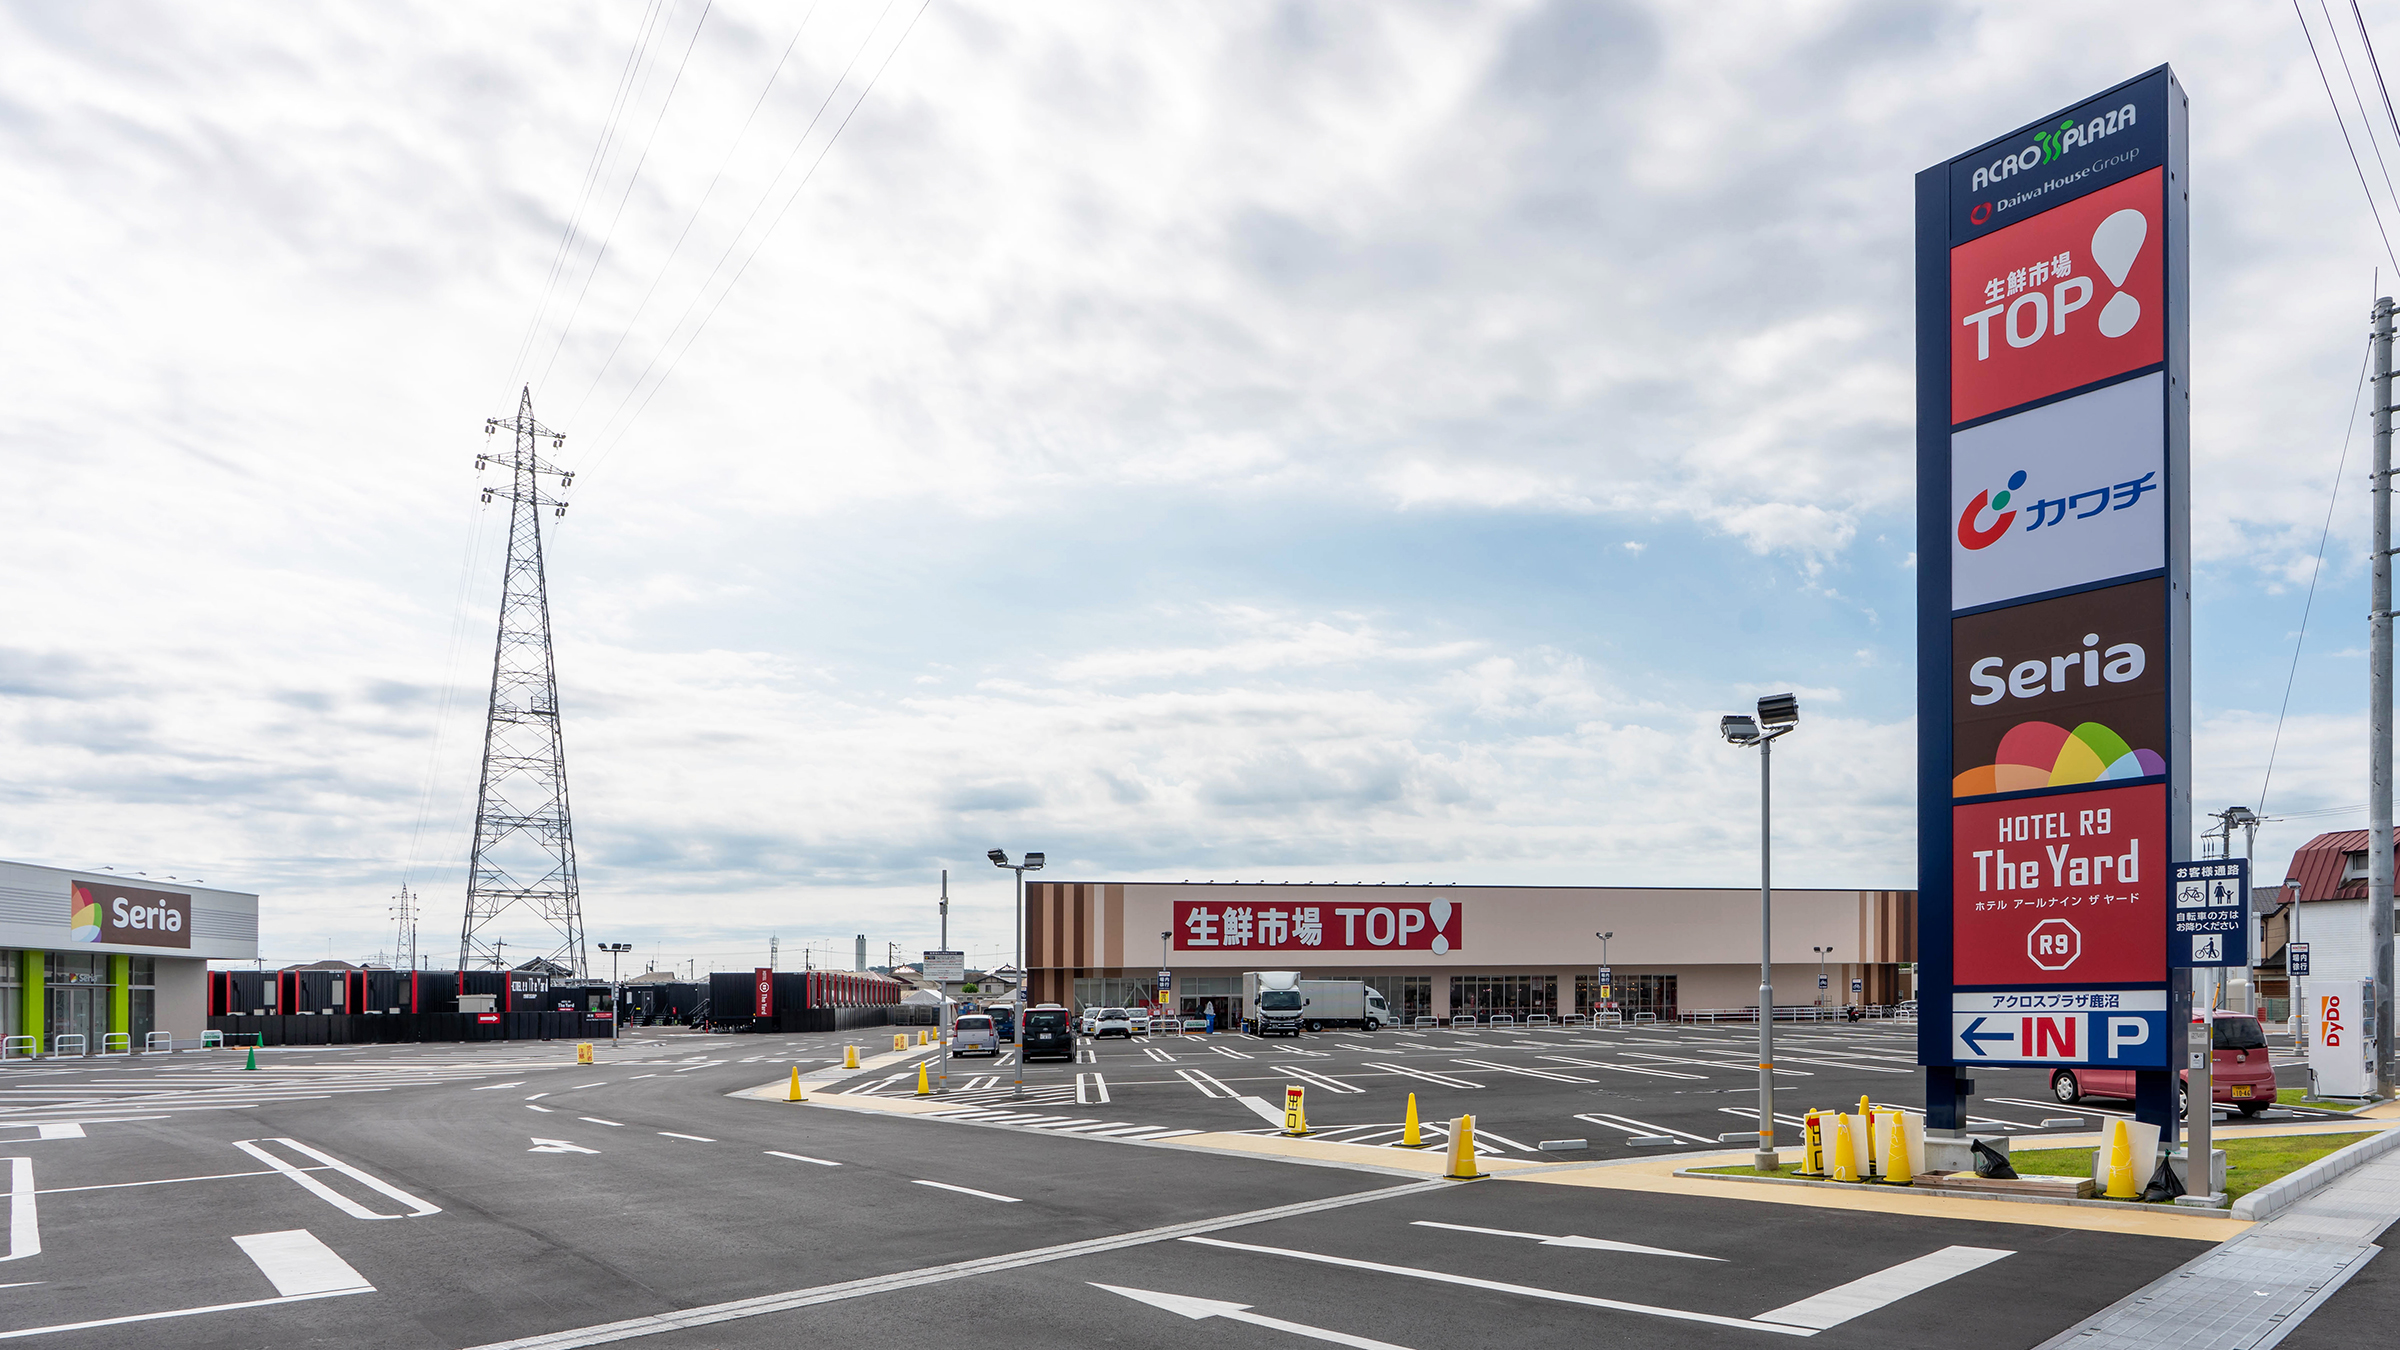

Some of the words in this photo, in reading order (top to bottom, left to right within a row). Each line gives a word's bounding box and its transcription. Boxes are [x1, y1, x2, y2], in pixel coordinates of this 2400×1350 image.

[1997, 187, 2042, 212] Daiwa
[2044, 167, 2090, 194] House
[2092, 147, 2140, 173] Group
[1984, 251, 2072, 305] 生鮮市場
[2026, 471, 2157, 532] カワチ
[1969, 633, 2146, 706] Seria
[1999, 812, 2071, 842] HOTEL
[2080, 808, 2111, 836] R9
[1972, 849, 2039, 892] The
[2046, 838, 2139, 887] Yard
[2176, 864, 2240, 879] お客様通路
[112, 896, 182, 932] Seria
[1975, 900, 2008, 911] ホテル
[2013, 896, 2082, 909] アールナイン
[2103, 892, 2140, 905] ヤード
[2176, 910, 2239, 922] 自転車の方は
[1185, 906, 1323, 946] 生鮮市場
[2039, 934, 2068, 955] R9
[2176, 921, 2239, 932] お降りください
[1992, 994, 2120, 1008] アクロスプラザ鹿沼
[2021, 1017, 2076, 1057] IN
[2107, 1016, 2149, 1059] P
[2326, 996, 2344, 1047] DyDo
